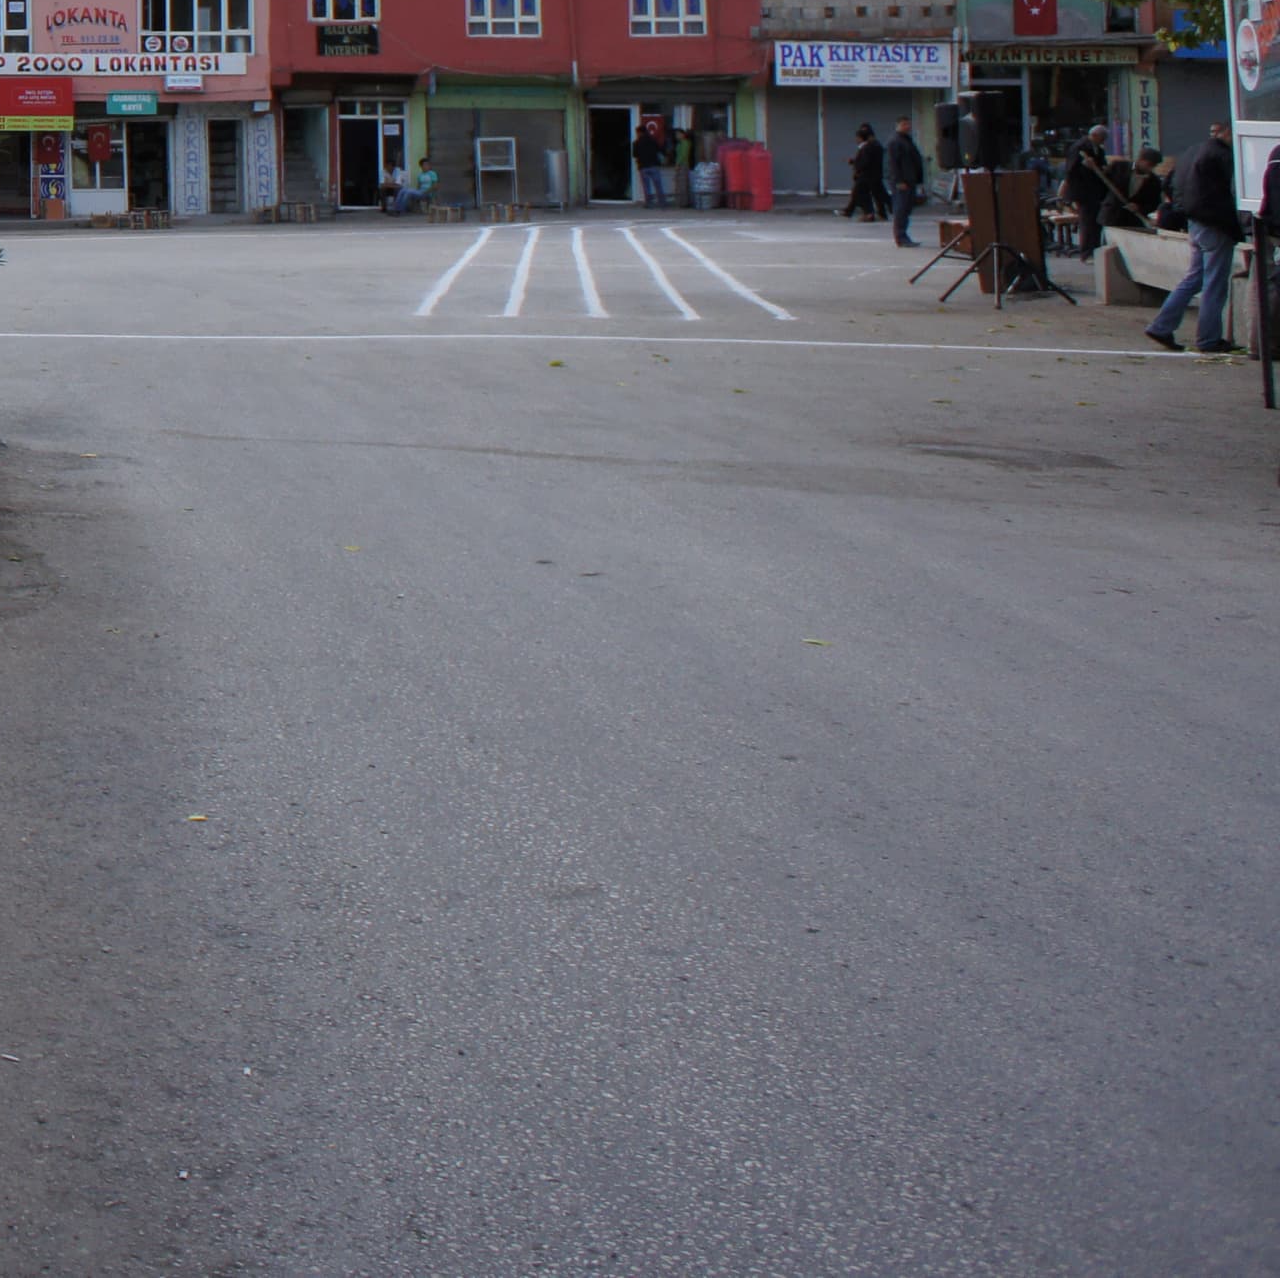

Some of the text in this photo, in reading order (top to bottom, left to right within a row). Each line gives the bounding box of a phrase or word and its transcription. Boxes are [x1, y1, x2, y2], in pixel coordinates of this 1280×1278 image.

[46, 7, 128, 32] LOKANTA
[16, 55, 84, 72] 2000
[94, 55, 220, 72] LOKANTASI
[779, 44, 825, 68] PAK
